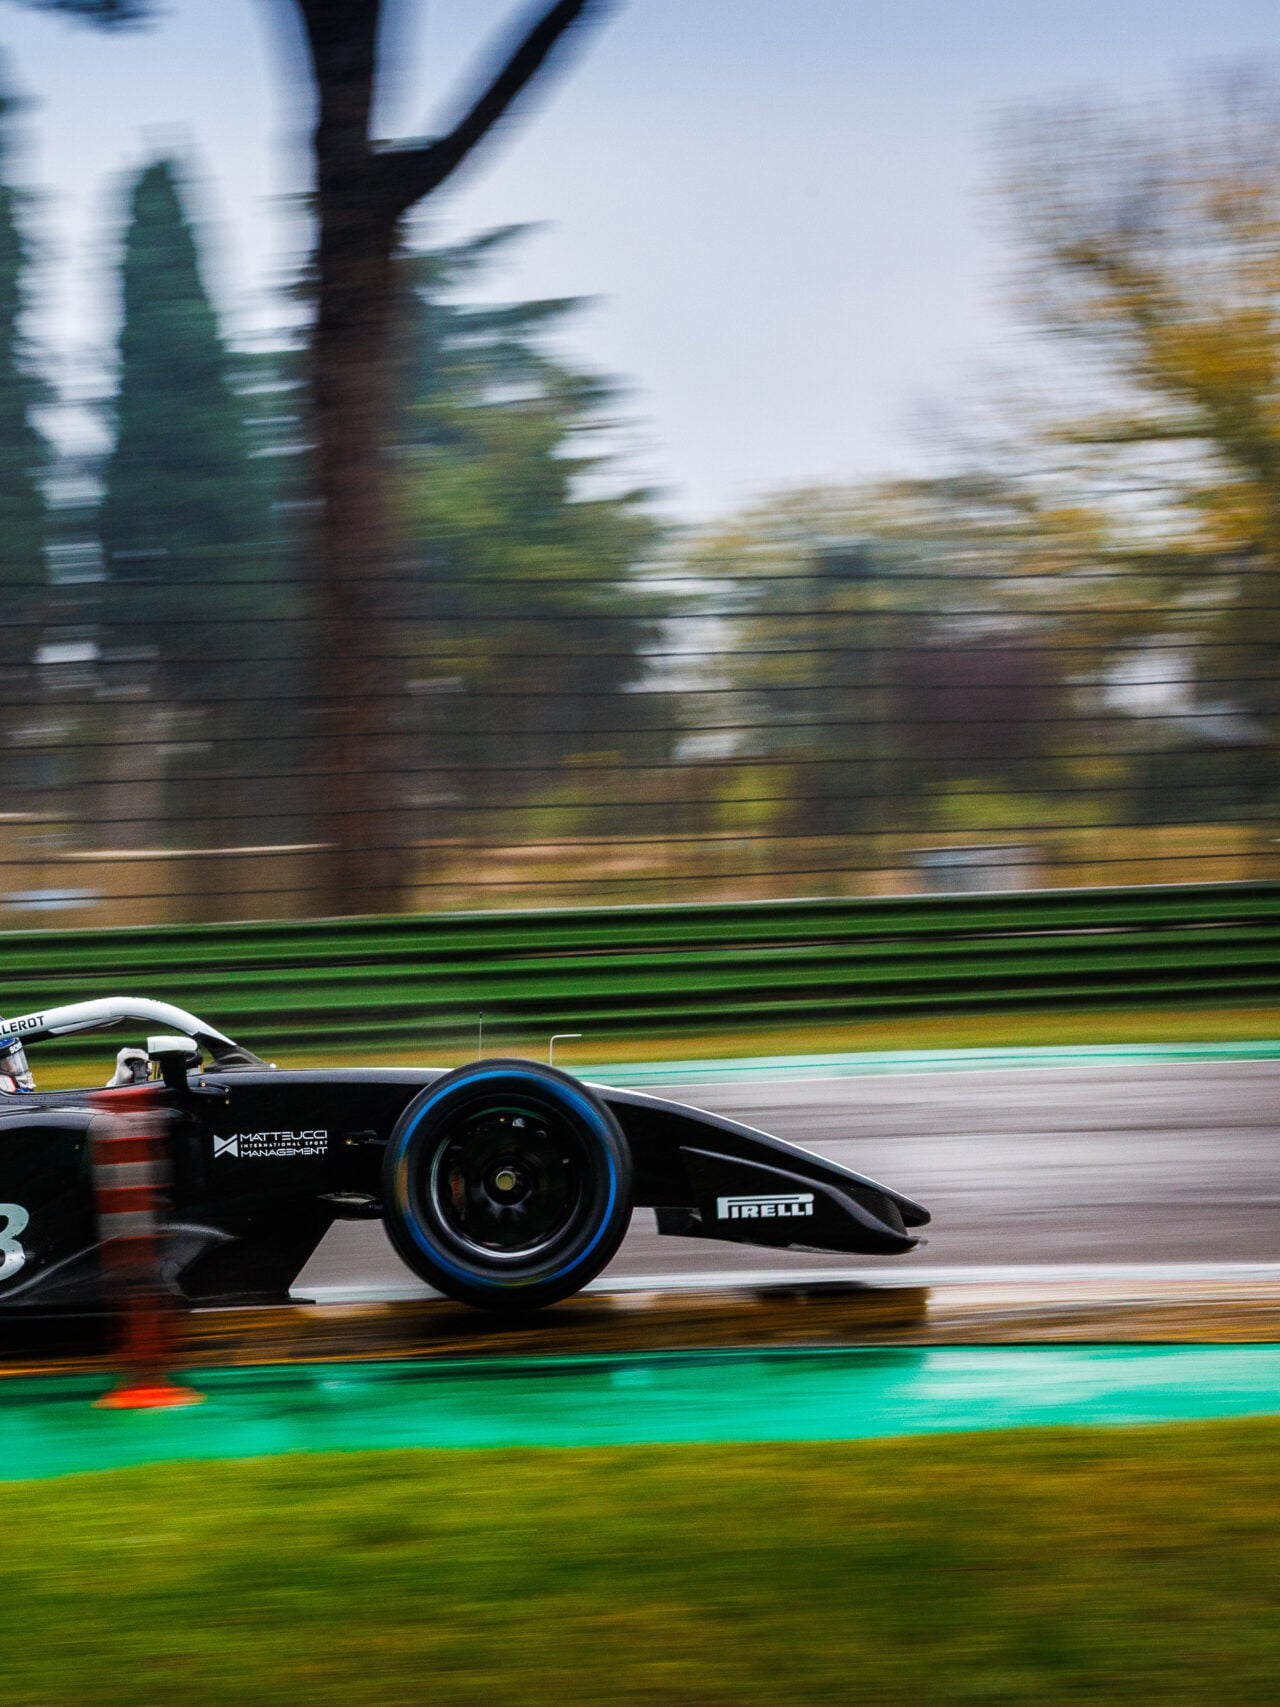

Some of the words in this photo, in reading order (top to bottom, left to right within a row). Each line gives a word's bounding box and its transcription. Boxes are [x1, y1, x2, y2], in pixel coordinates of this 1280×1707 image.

[240, 1130, 328, 1142] MATTEUCCI
[240, 1147, 328, 1157] MANAGEMENT
[717, 1193, 814, 1219] PIRELLI
